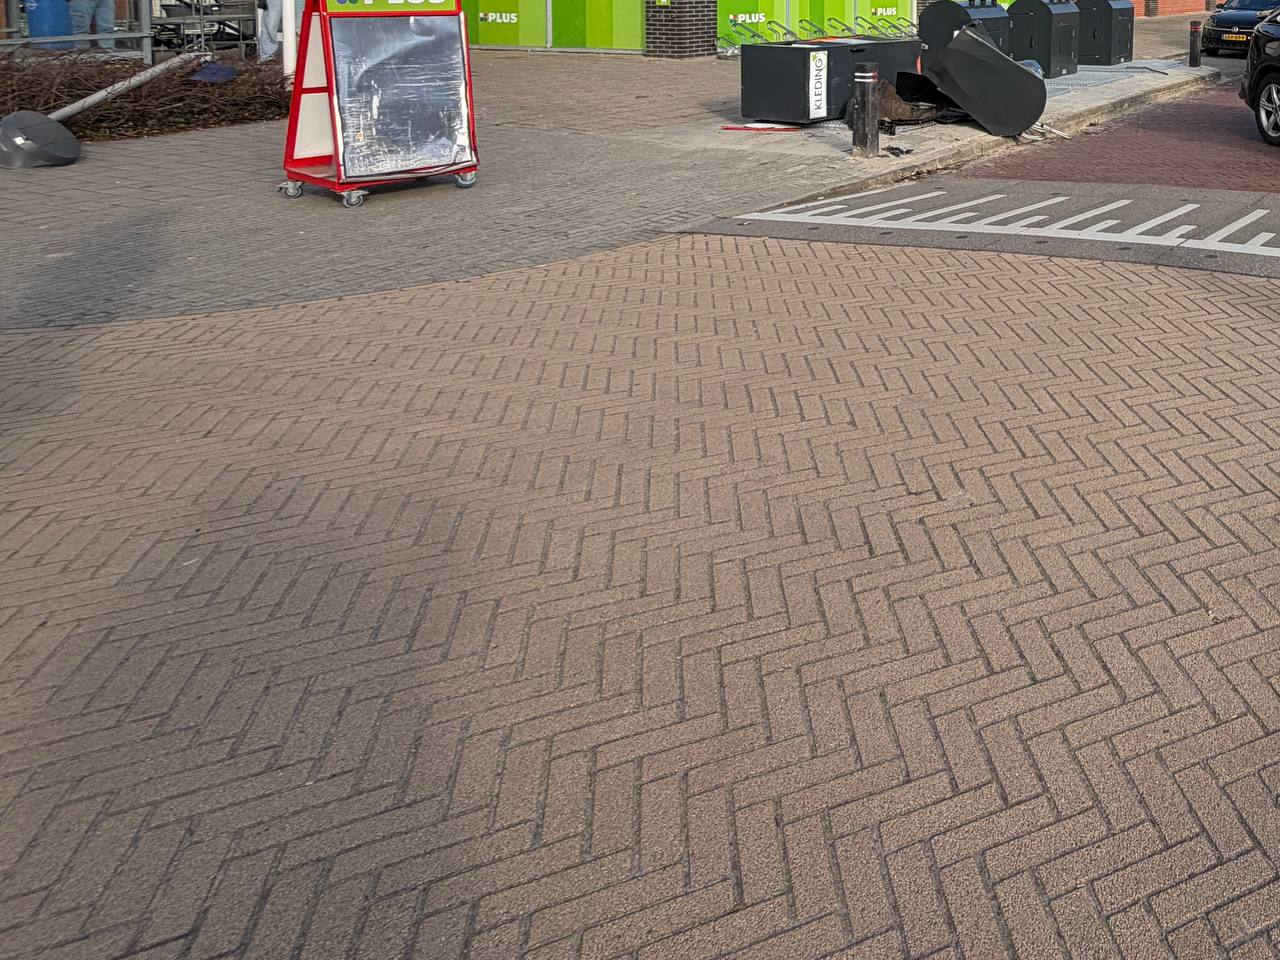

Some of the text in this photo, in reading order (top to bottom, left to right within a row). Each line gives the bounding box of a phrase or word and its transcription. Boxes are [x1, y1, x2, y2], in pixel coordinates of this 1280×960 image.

[488, 12, 518, 23] PLUS
[877, 7, 897, 17] PLUS
[737, 13, 766, 24] PLUS
[814, 57, 824, 111] KLEDING
